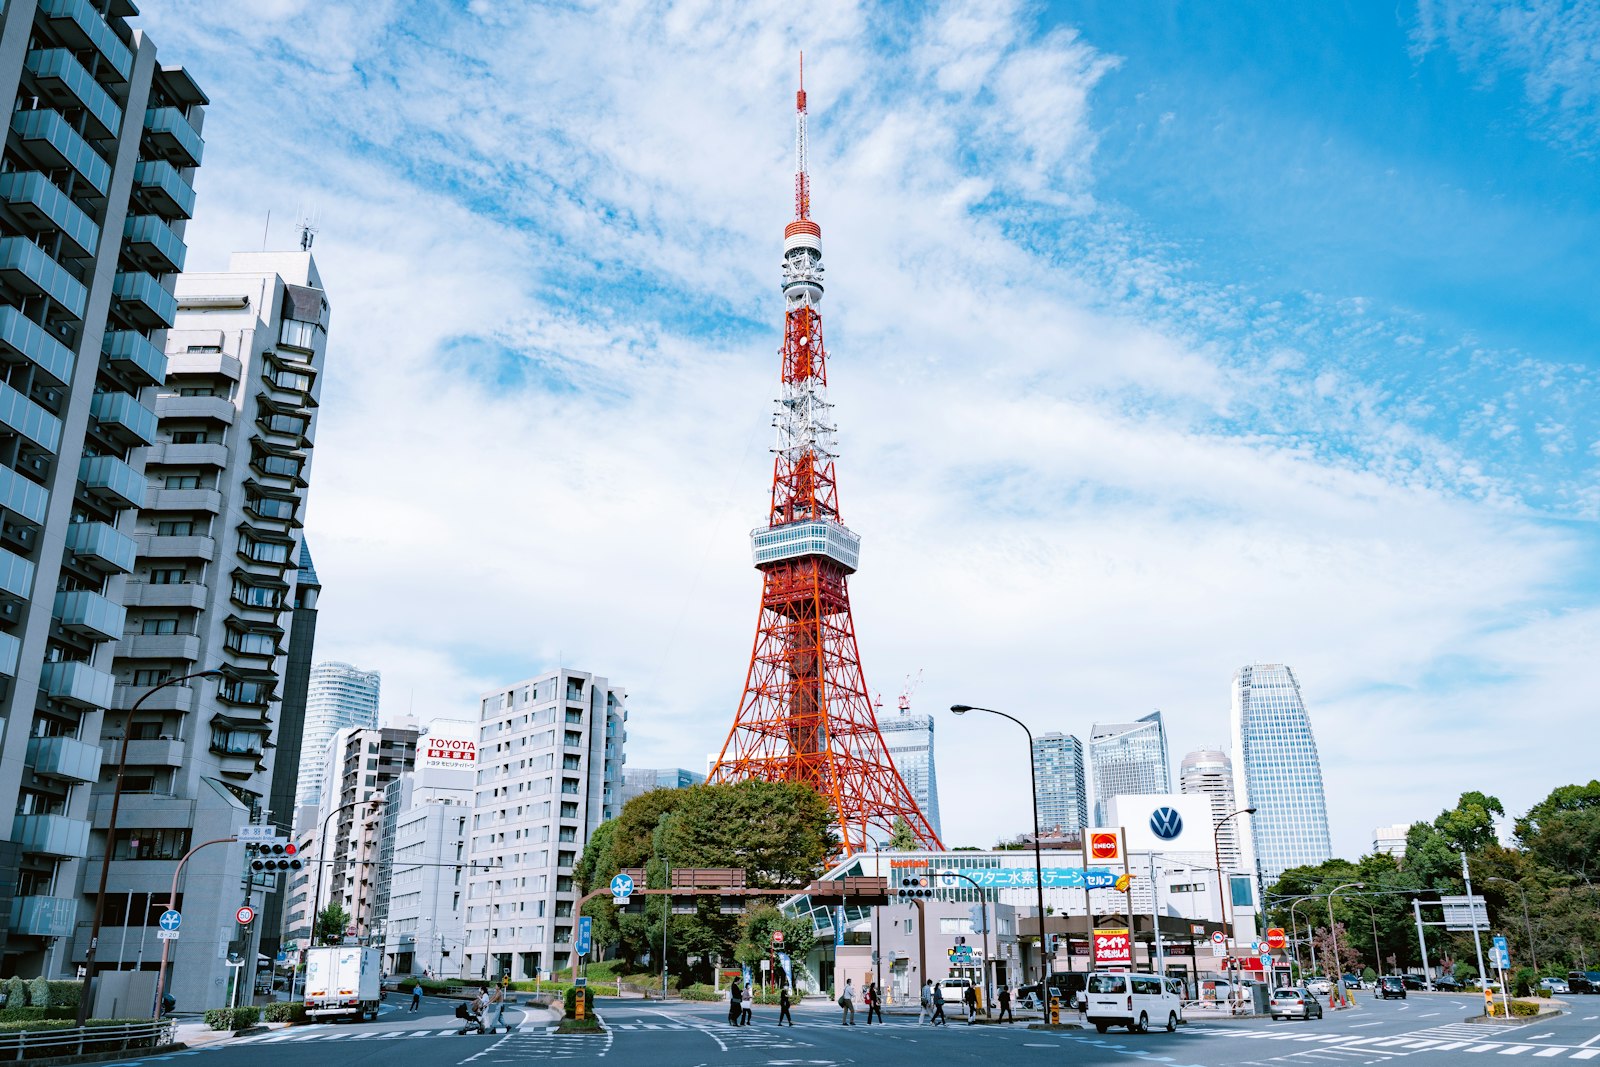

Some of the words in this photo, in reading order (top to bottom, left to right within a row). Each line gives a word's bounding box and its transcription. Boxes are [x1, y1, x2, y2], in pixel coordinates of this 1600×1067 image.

[428, 738, 476, 751] TOYOTA
[961, 871, 1084, 885] イワタニ水素ステーシ
[1086, 875, 1114, 886] セルフ
[239, 911, 250, 919] 50
[1096, 936, 1126, 948] タイヤ
